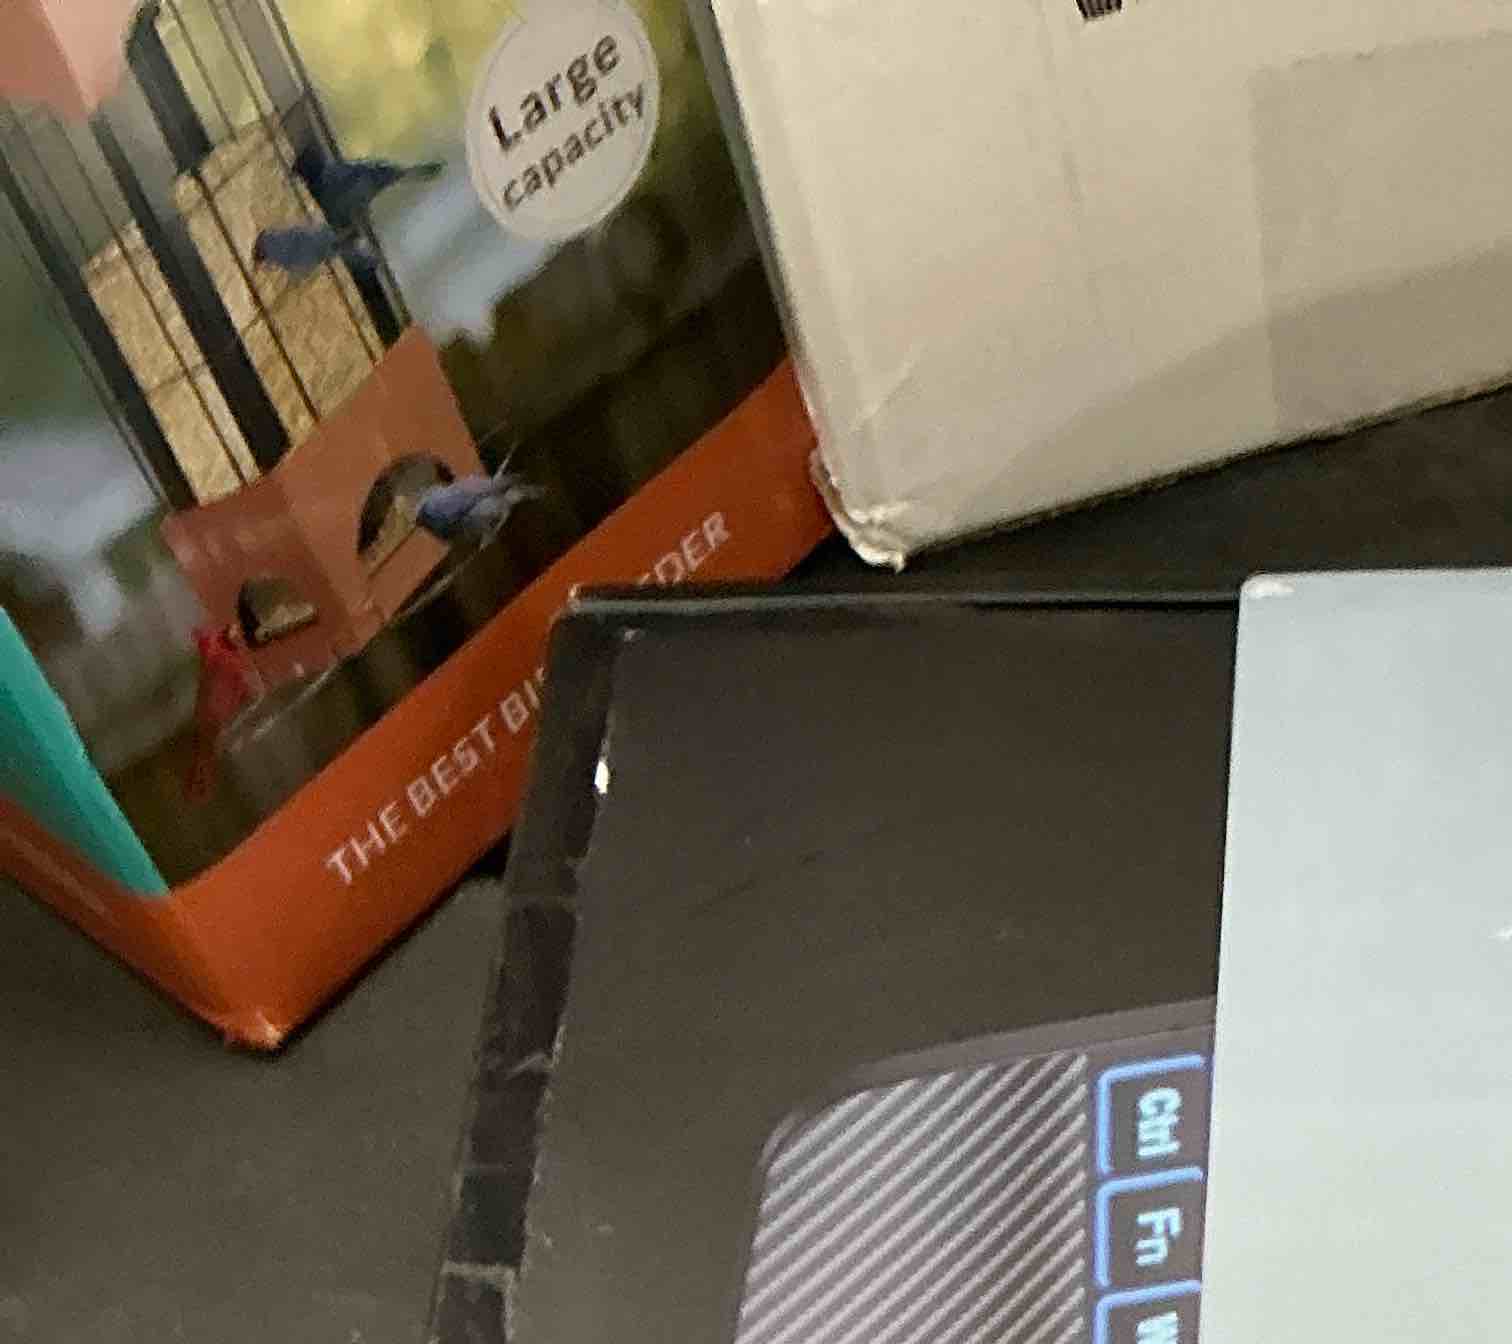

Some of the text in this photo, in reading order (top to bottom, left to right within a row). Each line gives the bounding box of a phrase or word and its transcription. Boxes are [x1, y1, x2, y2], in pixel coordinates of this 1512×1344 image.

[489, 35, 620, 151] Large
[503, 84, 644, 210] capacity
[326, 801, 407, 884] THE
[407, 715, 495, 817] BEST
[1136, 1087, 1181, 1157] Ctrl
[1134, 1207, 1181, 1266] Fn
